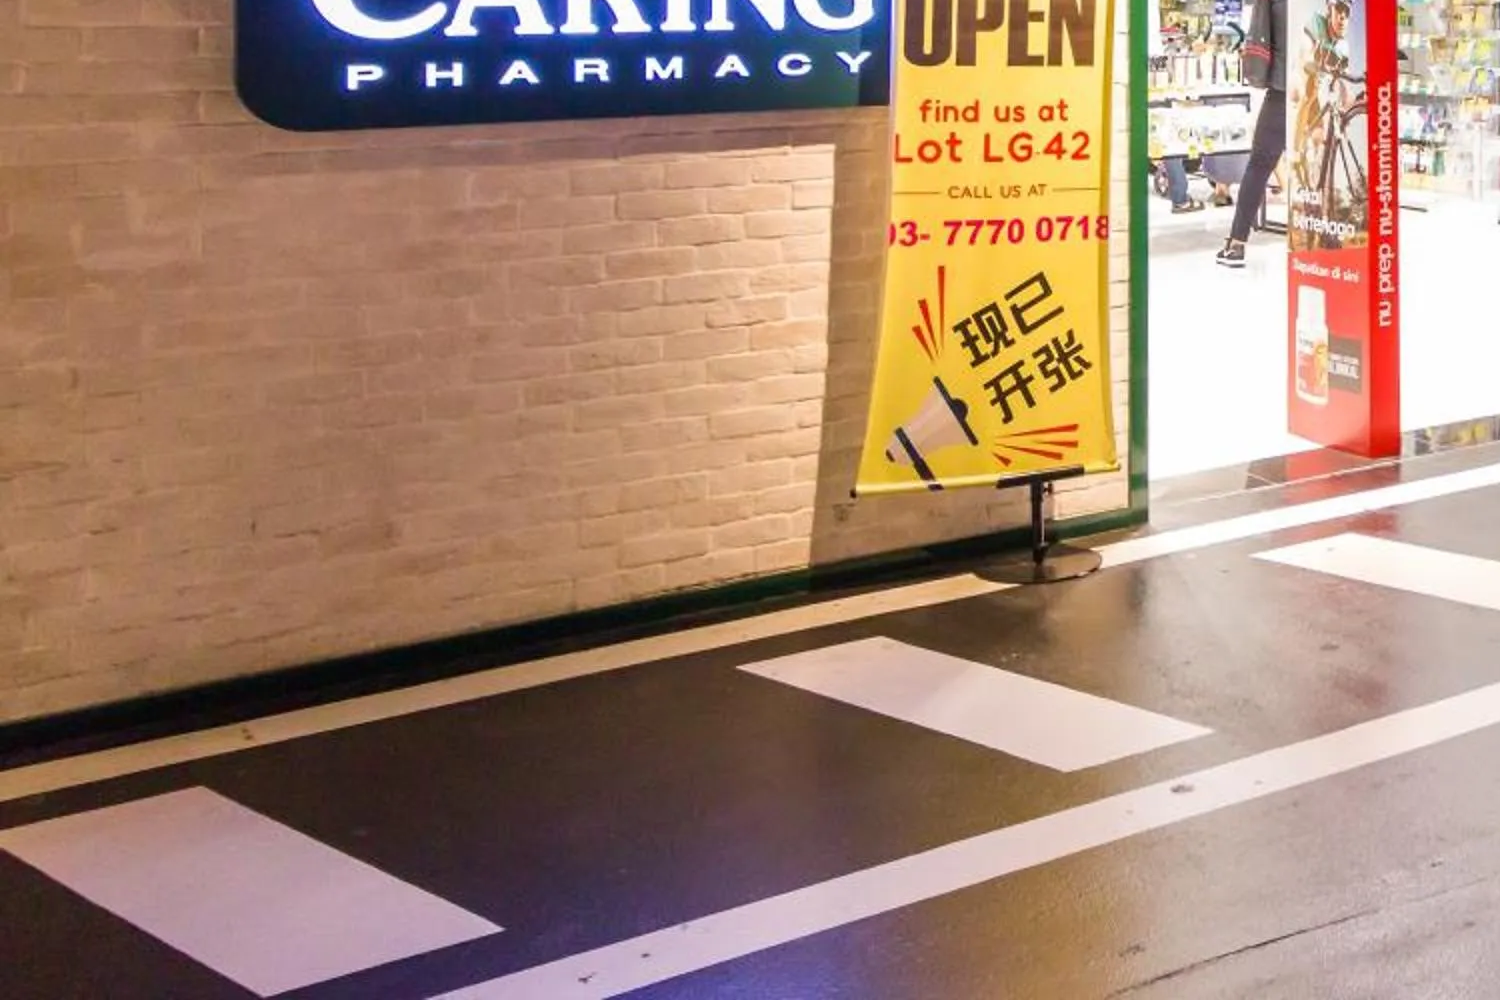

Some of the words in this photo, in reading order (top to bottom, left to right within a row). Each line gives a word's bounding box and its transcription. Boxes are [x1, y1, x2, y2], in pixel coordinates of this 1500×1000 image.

[346, 51, 873, 91] PHARMACY
[919, 99, 981, 123] find
[994, 105, 1025, 123] us
[1037, 98, 1069, 122] at
[894, 131, 963, 163] Lot
[947, 185, 992, 199] CALL
[1000, 185, 1021, 198] US
[1027, 184, 1048, 197] AT
[943, 218, 1025, 246] 7770
[1036, 215, 1109, 242] 0718
[1377, 243, 1395, 294] prep
[1378, 300, 1392, 327] nu
[983, 328, 1093, 425] 开张
